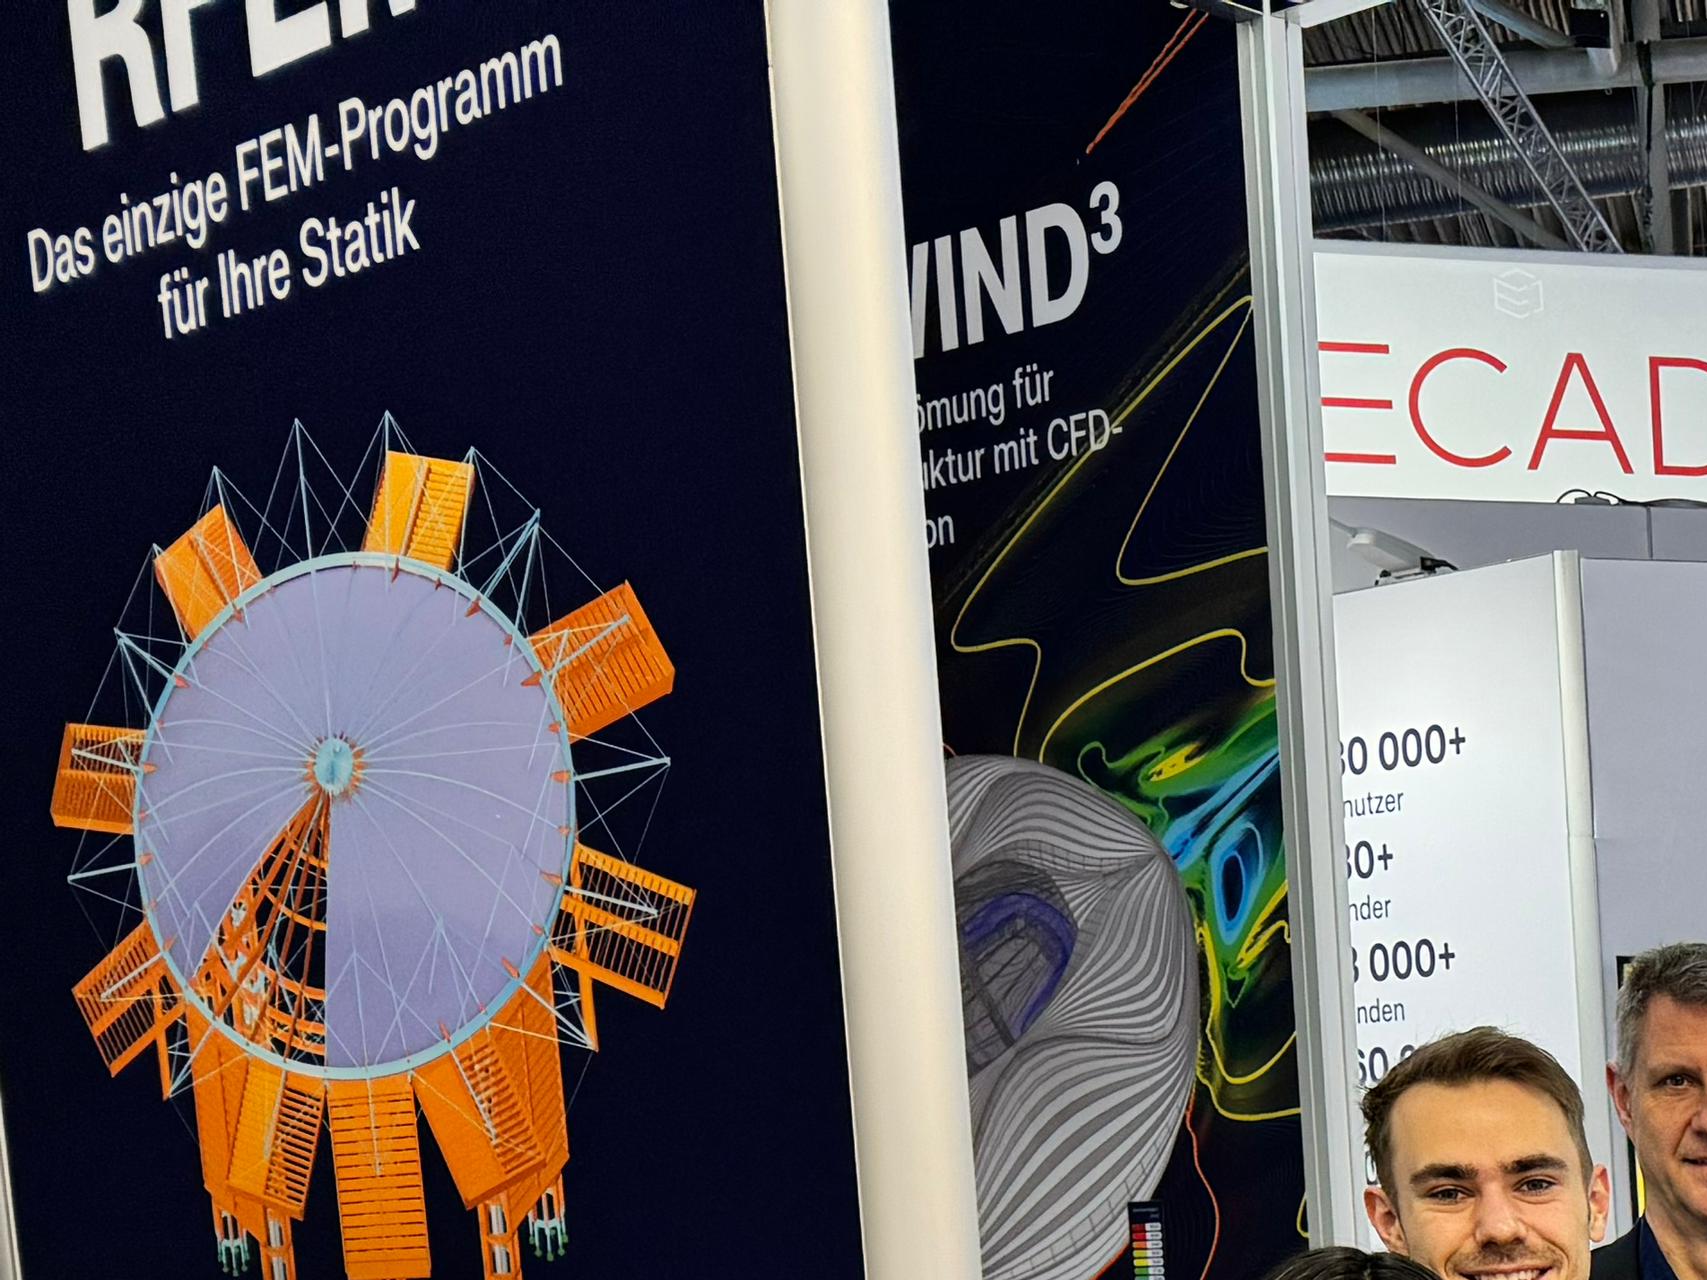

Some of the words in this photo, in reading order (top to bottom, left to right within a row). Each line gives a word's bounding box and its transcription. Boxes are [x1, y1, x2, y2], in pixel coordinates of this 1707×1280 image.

[27, 227, 95, 293] Das
[103, 171, 228, 263] einzige
[236, 33, 564, 211] FEM-Programm
[157, 267, 208, 339] für
[218, 249, 291, 318] Ihre
[300, 187, 421, 288] Statik
[1012, 362, 1055, 409] für
[993, 427, 1040, 475] mit
[1047, 408, 1123, 462] CFD-
[1378, 724, 1466, 771] 000+
[1369, 938, 1456, 982] 000+
[1357, 997, 1406, 1024] nden
